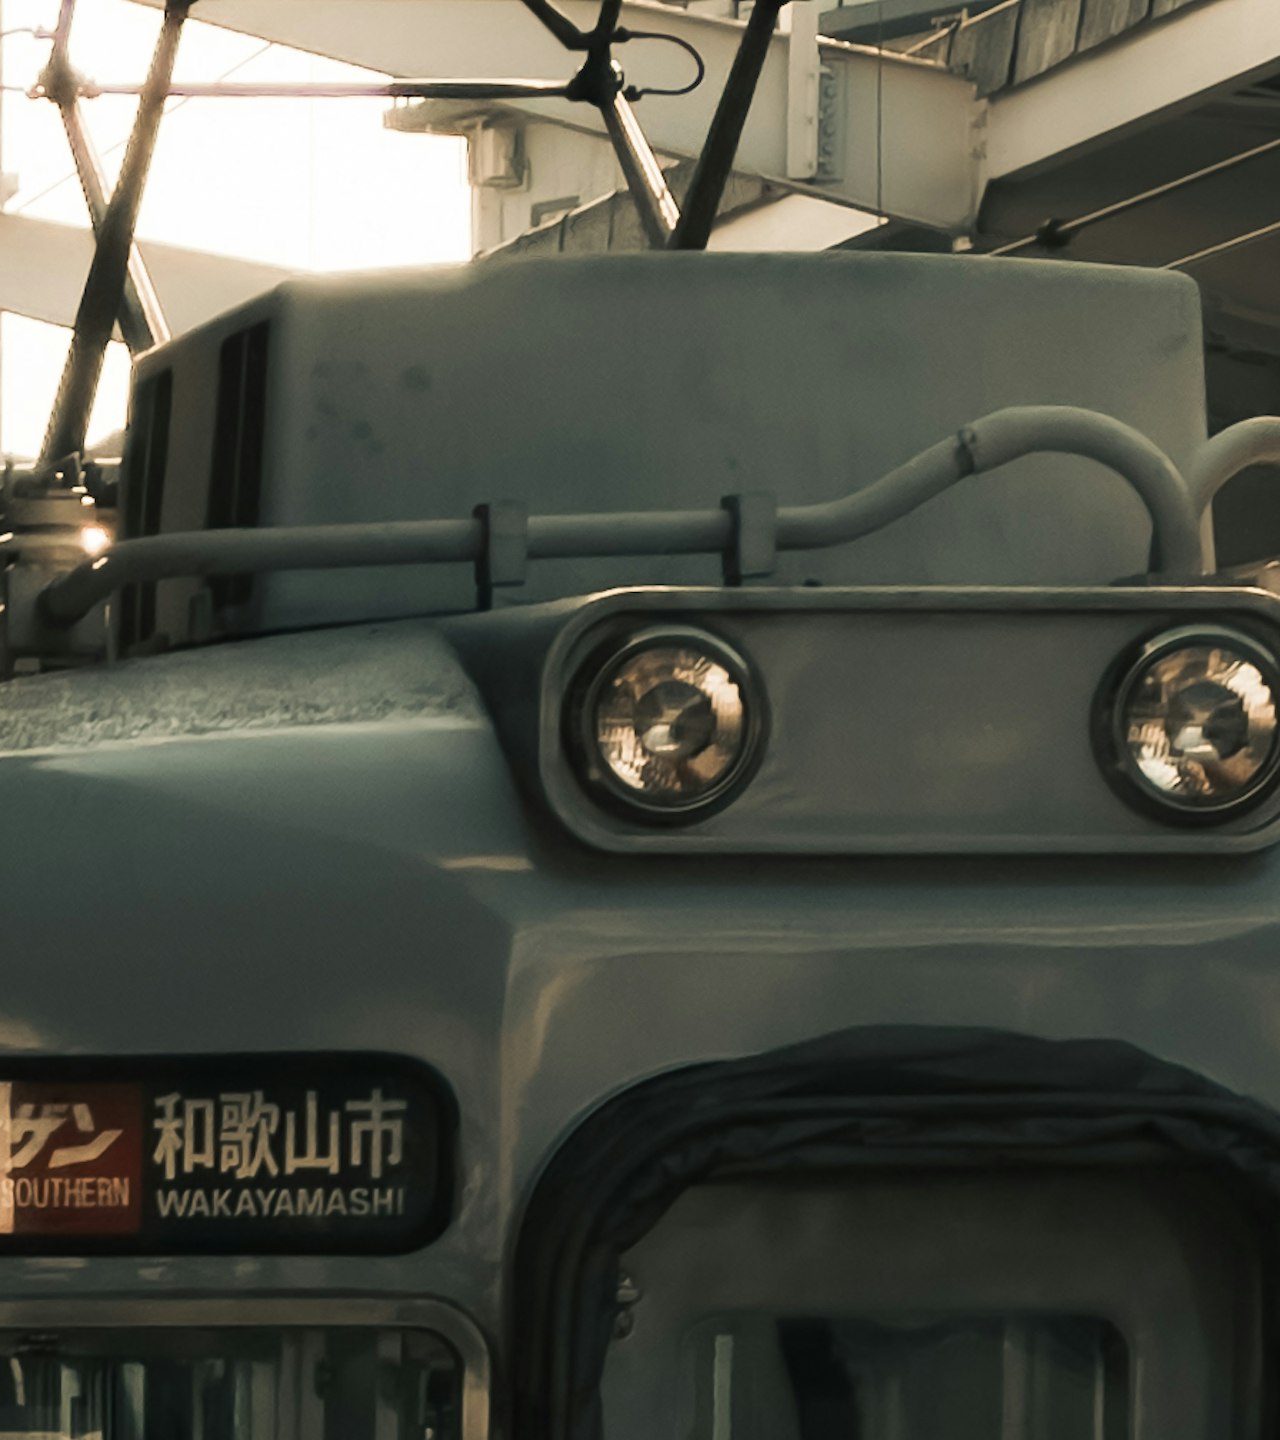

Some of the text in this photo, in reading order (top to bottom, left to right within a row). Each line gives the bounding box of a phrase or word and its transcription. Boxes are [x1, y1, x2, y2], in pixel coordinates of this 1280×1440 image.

[152, 1090, 408, 1180] 和歌山市
[0, 1176, 131, 1208] SOUTHERN
[156, 1187, 404, 1219] WAKAYAMASHI
